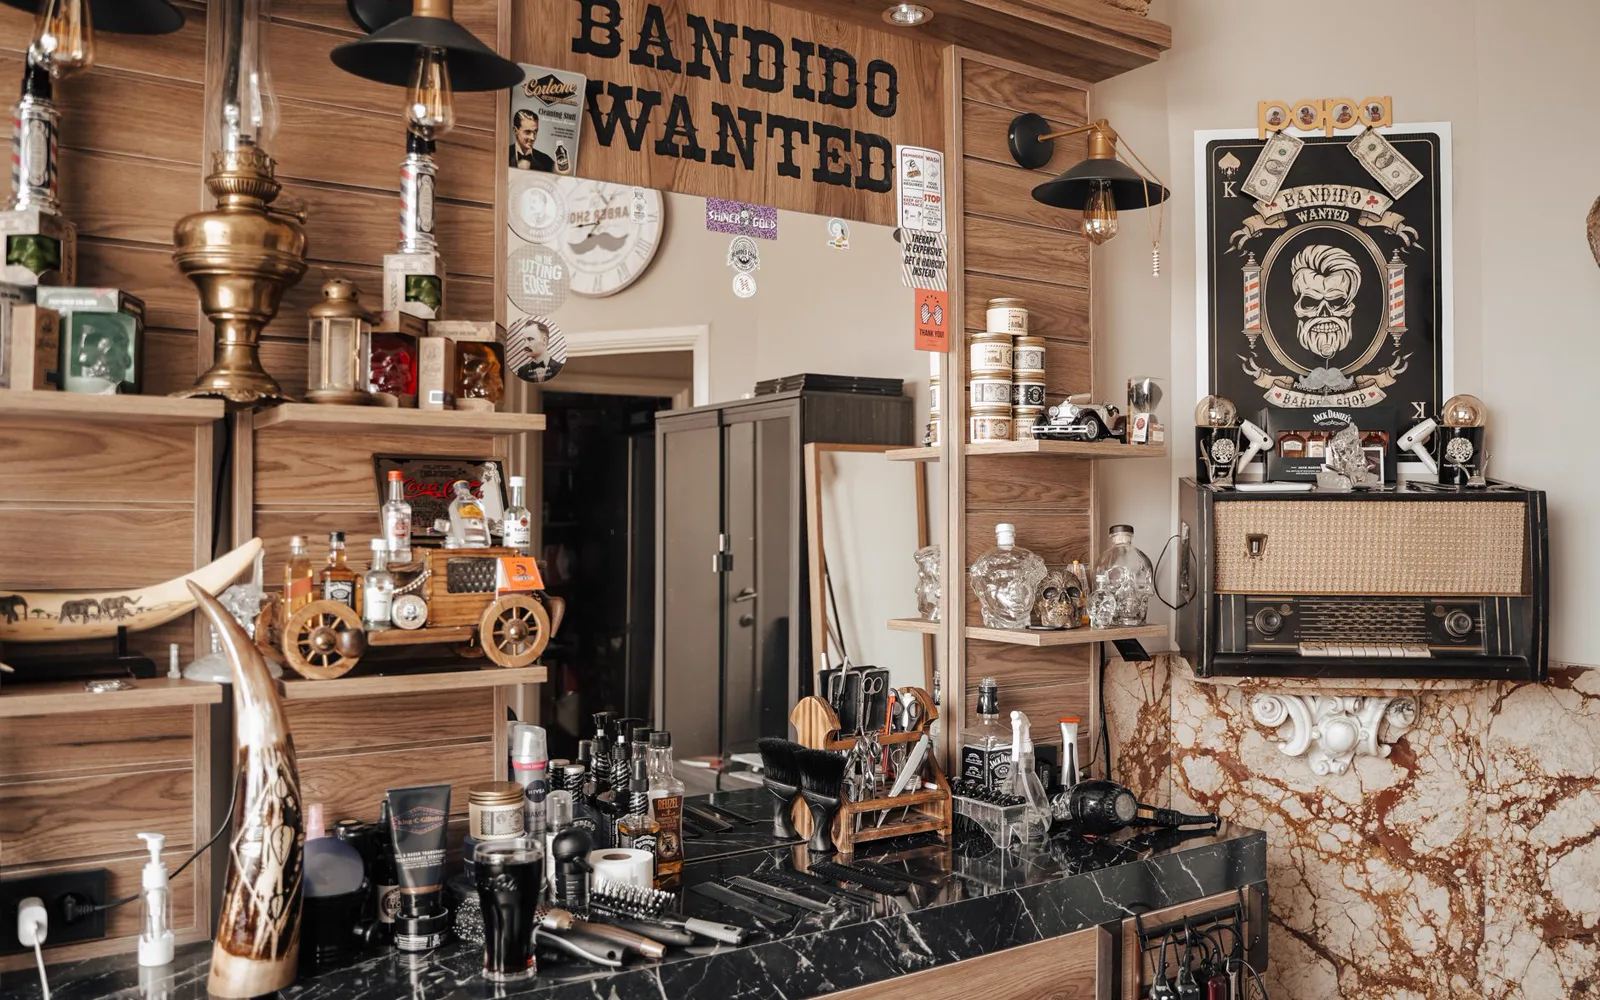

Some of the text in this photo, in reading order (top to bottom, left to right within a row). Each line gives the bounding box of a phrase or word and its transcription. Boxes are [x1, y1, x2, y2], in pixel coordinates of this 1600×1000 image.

[571, 0, 899, 118] BANDIDO
[524, 78, 577, 97] Corleone
[538, 108, 562, 118] Cleaning
[586, 80, 895, 193] WANTED
[1222, 181, 1237, 198] K
[1282, 186, 1361, 208] BANDIDO
[924, 193, 940, 203] STOP
[708, 210, 776, 229] SHINER GOLD
[1296, 208, 1350, 223] WANTED
[911, 233, 937, 246] THERAPY
[905, 243, 942, 257] IS EXPENSIVE
[520, 259, 562, 280] UTTING
[904, 255, 945, 270] GET A HAIRCUT
[912, 267, 936, 279] INSTEAD
[919, 328, 944, 338] THANK YOU!
[1283, 393, 1366, 408] BARBE SHOP
[1313, 409, 1352, 423] JACK DANIEL'S
[1411, 402, 1426, 418] K
[989, 758, 1001, 770] JACK
[657, 797, 678, 810] REUZEL
